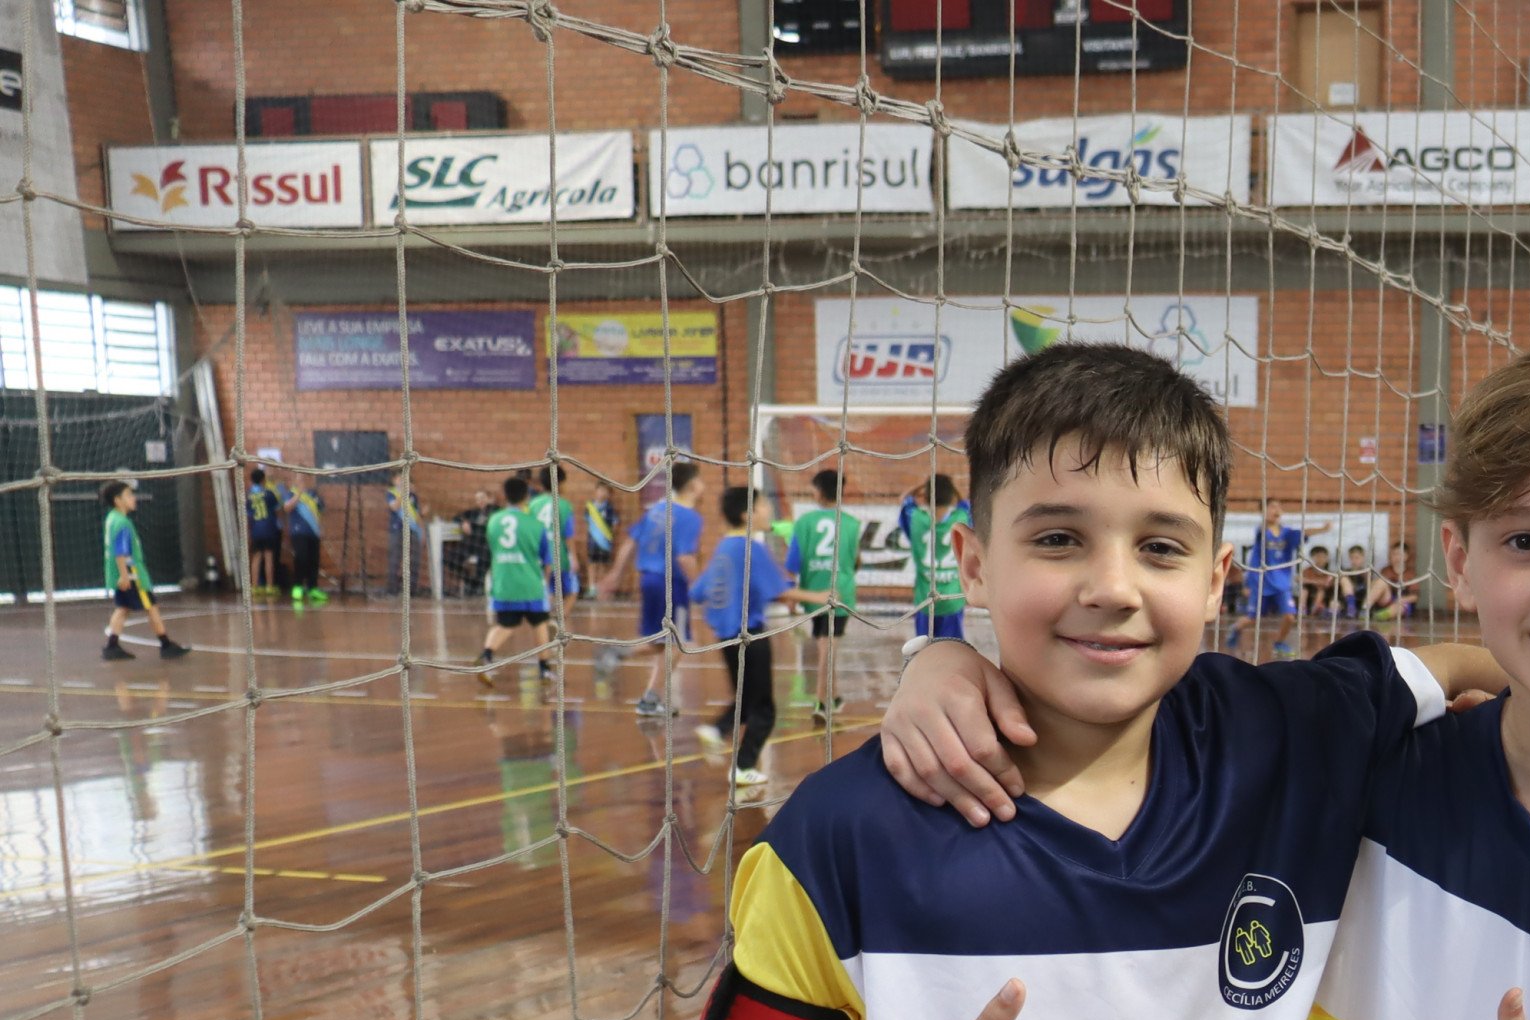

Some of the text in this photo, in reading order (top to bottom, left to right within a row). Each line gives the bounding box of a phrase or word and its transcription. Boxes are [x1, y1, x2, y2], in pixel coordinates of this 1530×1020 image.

[401, 155, 499, 189] SLC
[724, 148, 919, 190] banrisul
[1388, 147, 1516, 172] AGCO
[366, 320, 424, 335] EMPRSA
[499, 514, 518, 549] 3
[815, 518, 838, 557] 2
[1223, 947, 1300, 1006] CECÍLIA MEIRELES
